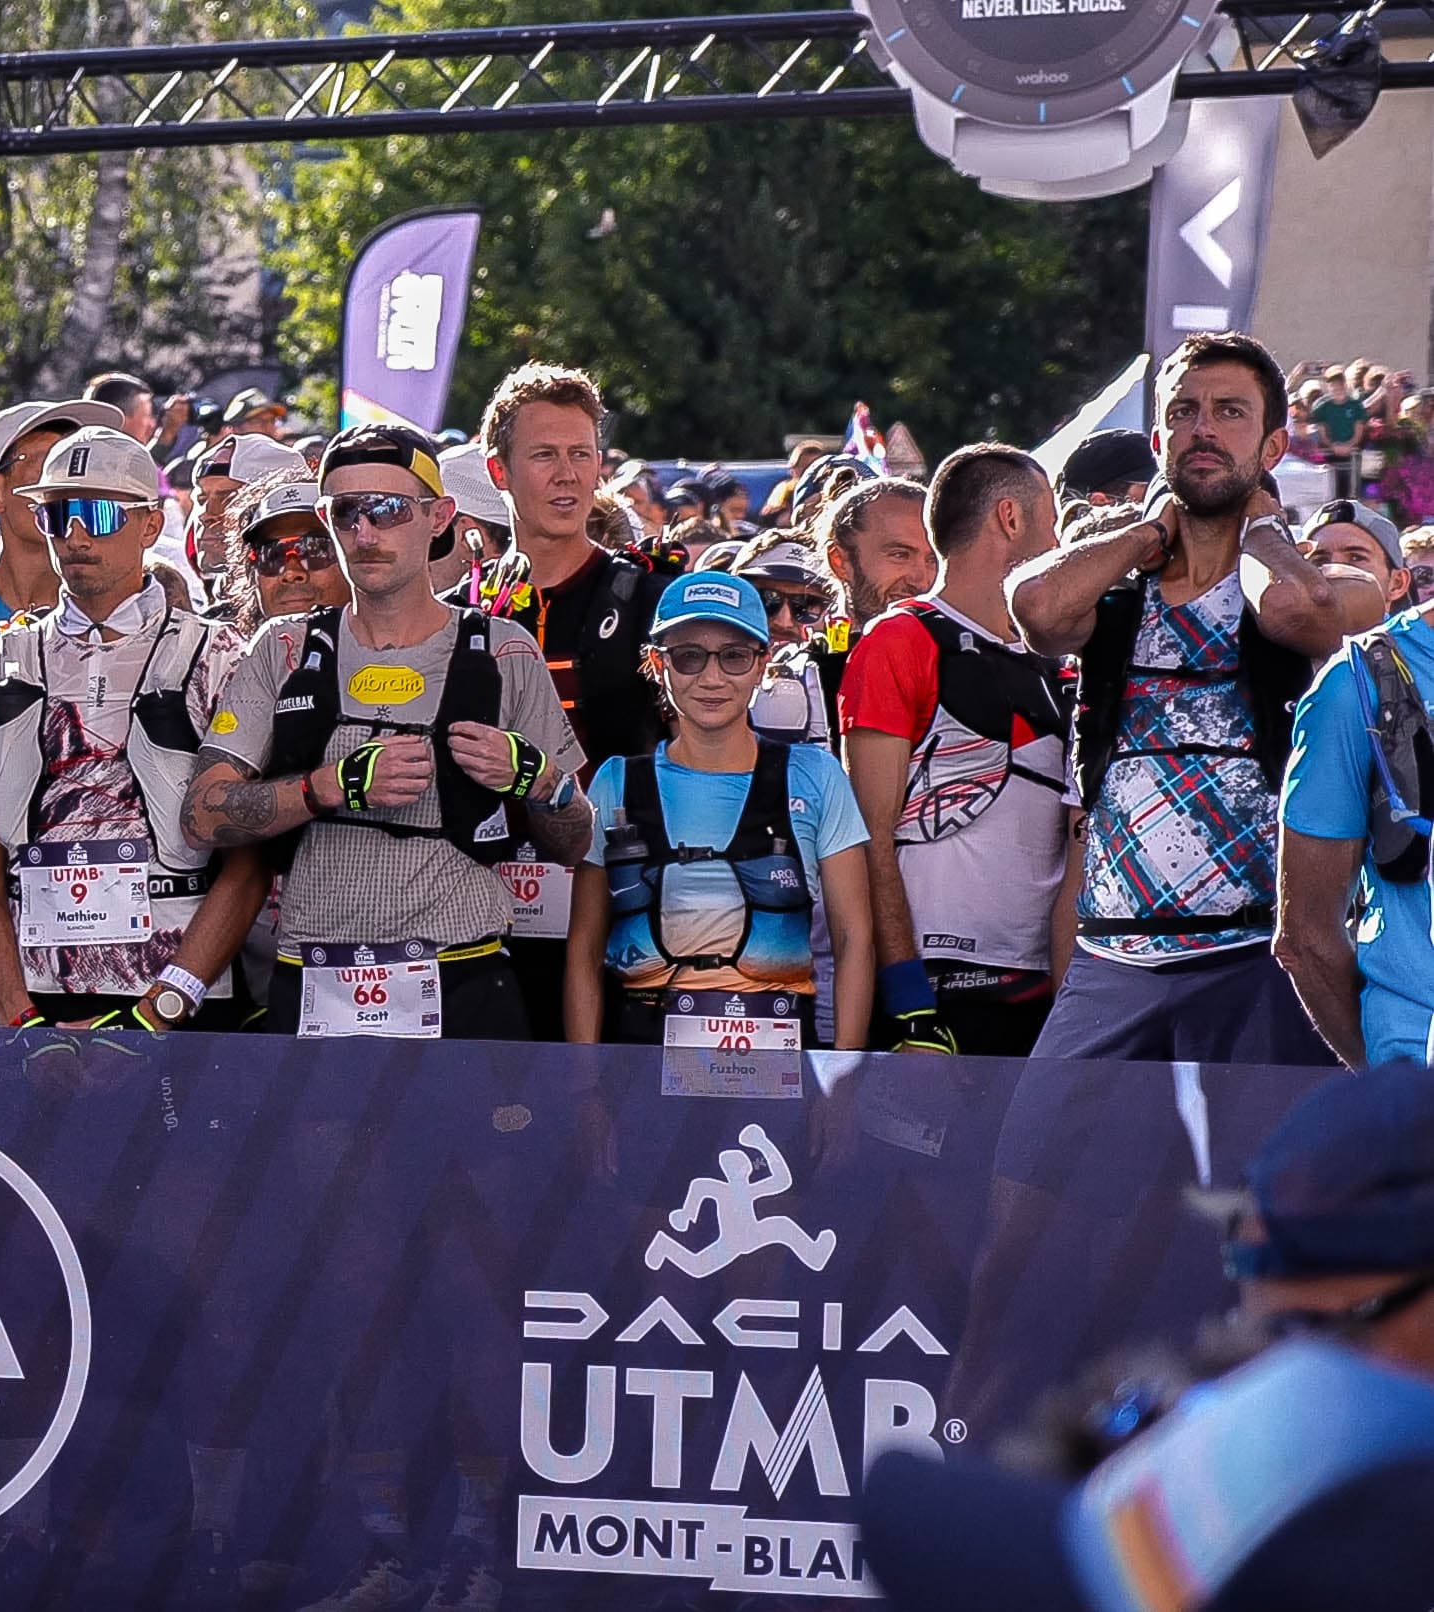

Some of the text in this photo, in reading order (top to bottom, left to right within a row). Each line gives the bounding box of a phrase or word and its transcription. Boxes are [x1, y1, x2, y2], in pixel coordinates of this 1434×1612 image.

[1016, 69, 1069, 85] wahoo
[350, 674, 424, 692] vibram
[53, 867, 99, 882] UTMB
[501, 864, 546, 877] UTMB
[70, 883, 88, 905] 9
[56, 910, 107, 923] Mathieu
[926, 936, 959, 947] BIG
[341, 967, 388, 983] UTMB
[353, 984, 388, 1006] 66
[356, 1011, 389, 1022] Scott
[707, 1019, 755, 1034] UTMB
[717, 1035, 752, 1057] 40
[709, 1063, 757, 1075] Fuzhao
[523, 1290, 951, 1356] DACIA
